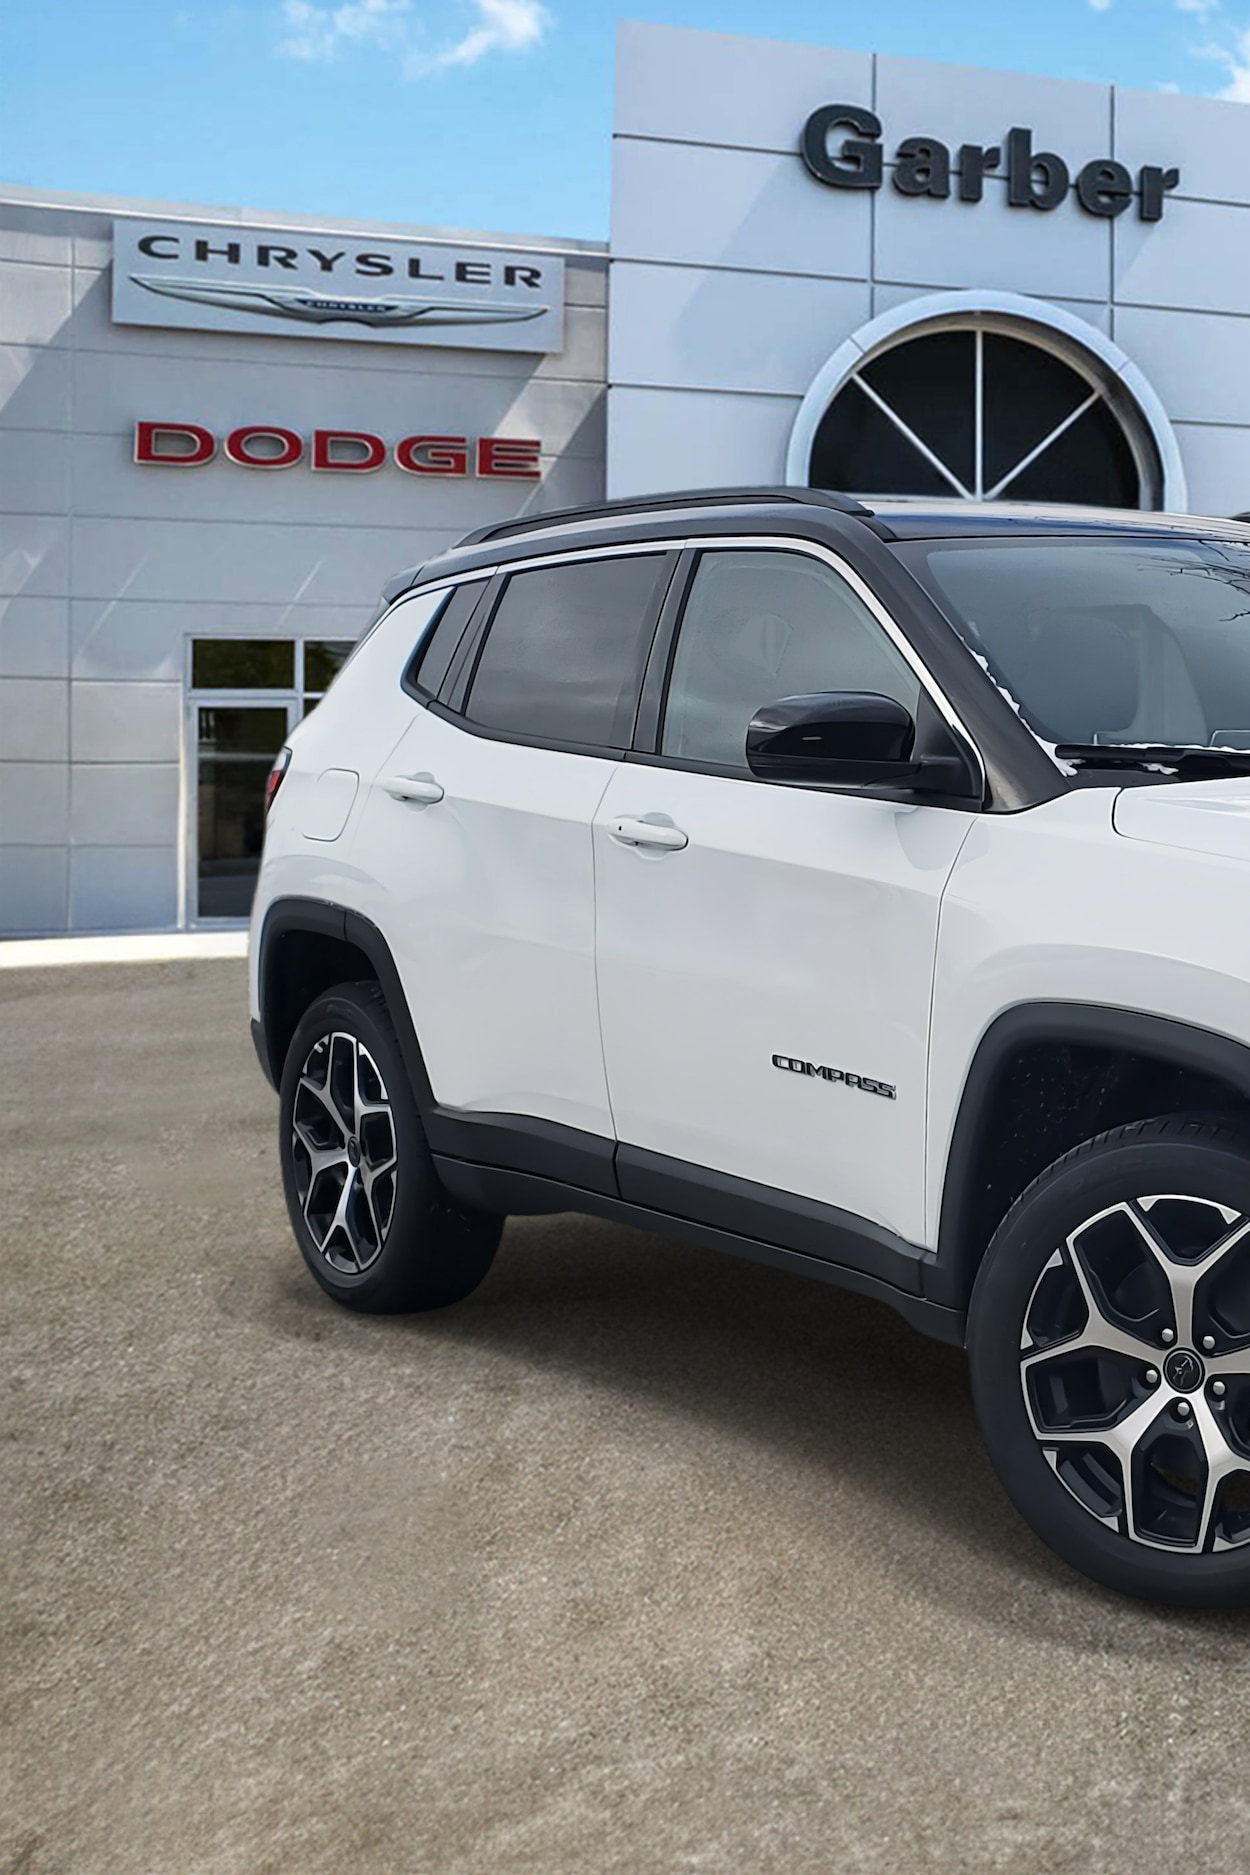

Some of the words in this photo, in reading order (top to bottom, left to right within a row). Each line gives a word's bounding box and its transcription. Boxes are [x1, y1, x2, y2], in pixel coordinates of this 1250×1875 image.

[802, 104, 1179, 222] Garber
[137, 234, 543, 289] CHRYSLER
[134, 421, 543, 479] DODGE
[772, 1054, 897, 1101] COMPASS
